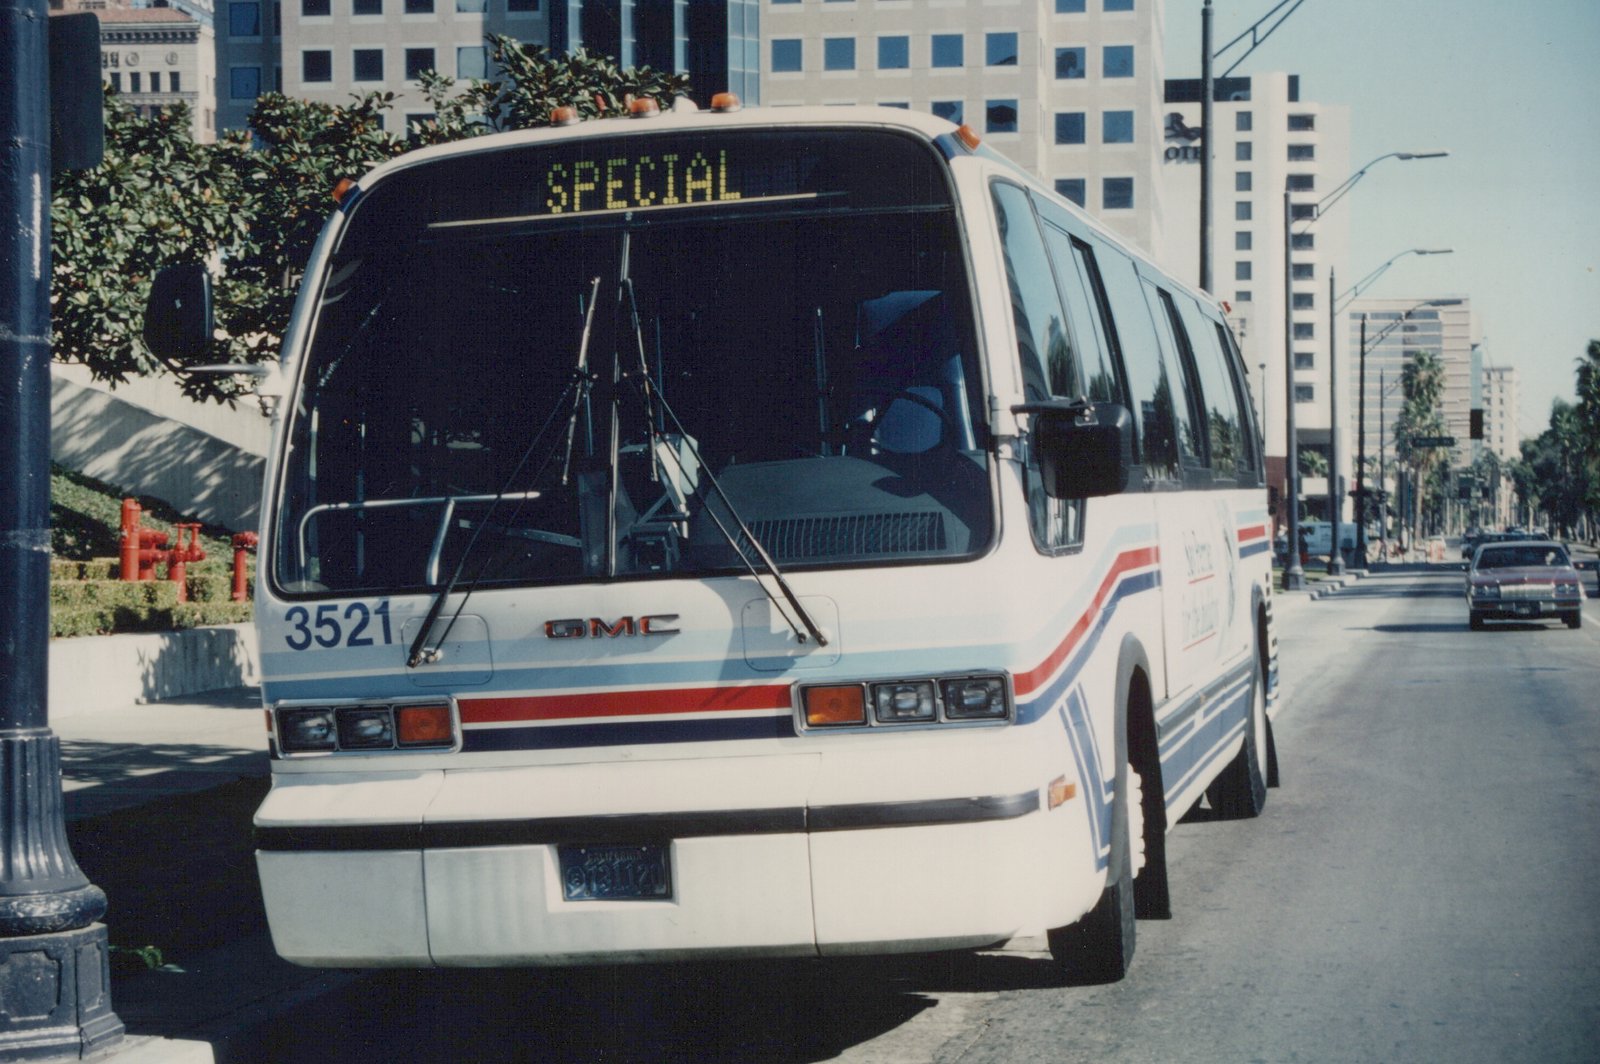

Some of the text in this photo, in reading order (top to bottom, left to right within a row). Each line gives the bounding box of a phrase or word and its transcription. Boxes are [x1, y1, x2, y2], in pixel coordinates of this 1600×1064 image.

[1163, 146, 1206, 161] OTE
[547, 150, 741, 213] SPECIAL
[285, 600, 392, 651] 3521
[544, 614, 681, 638] GMC
